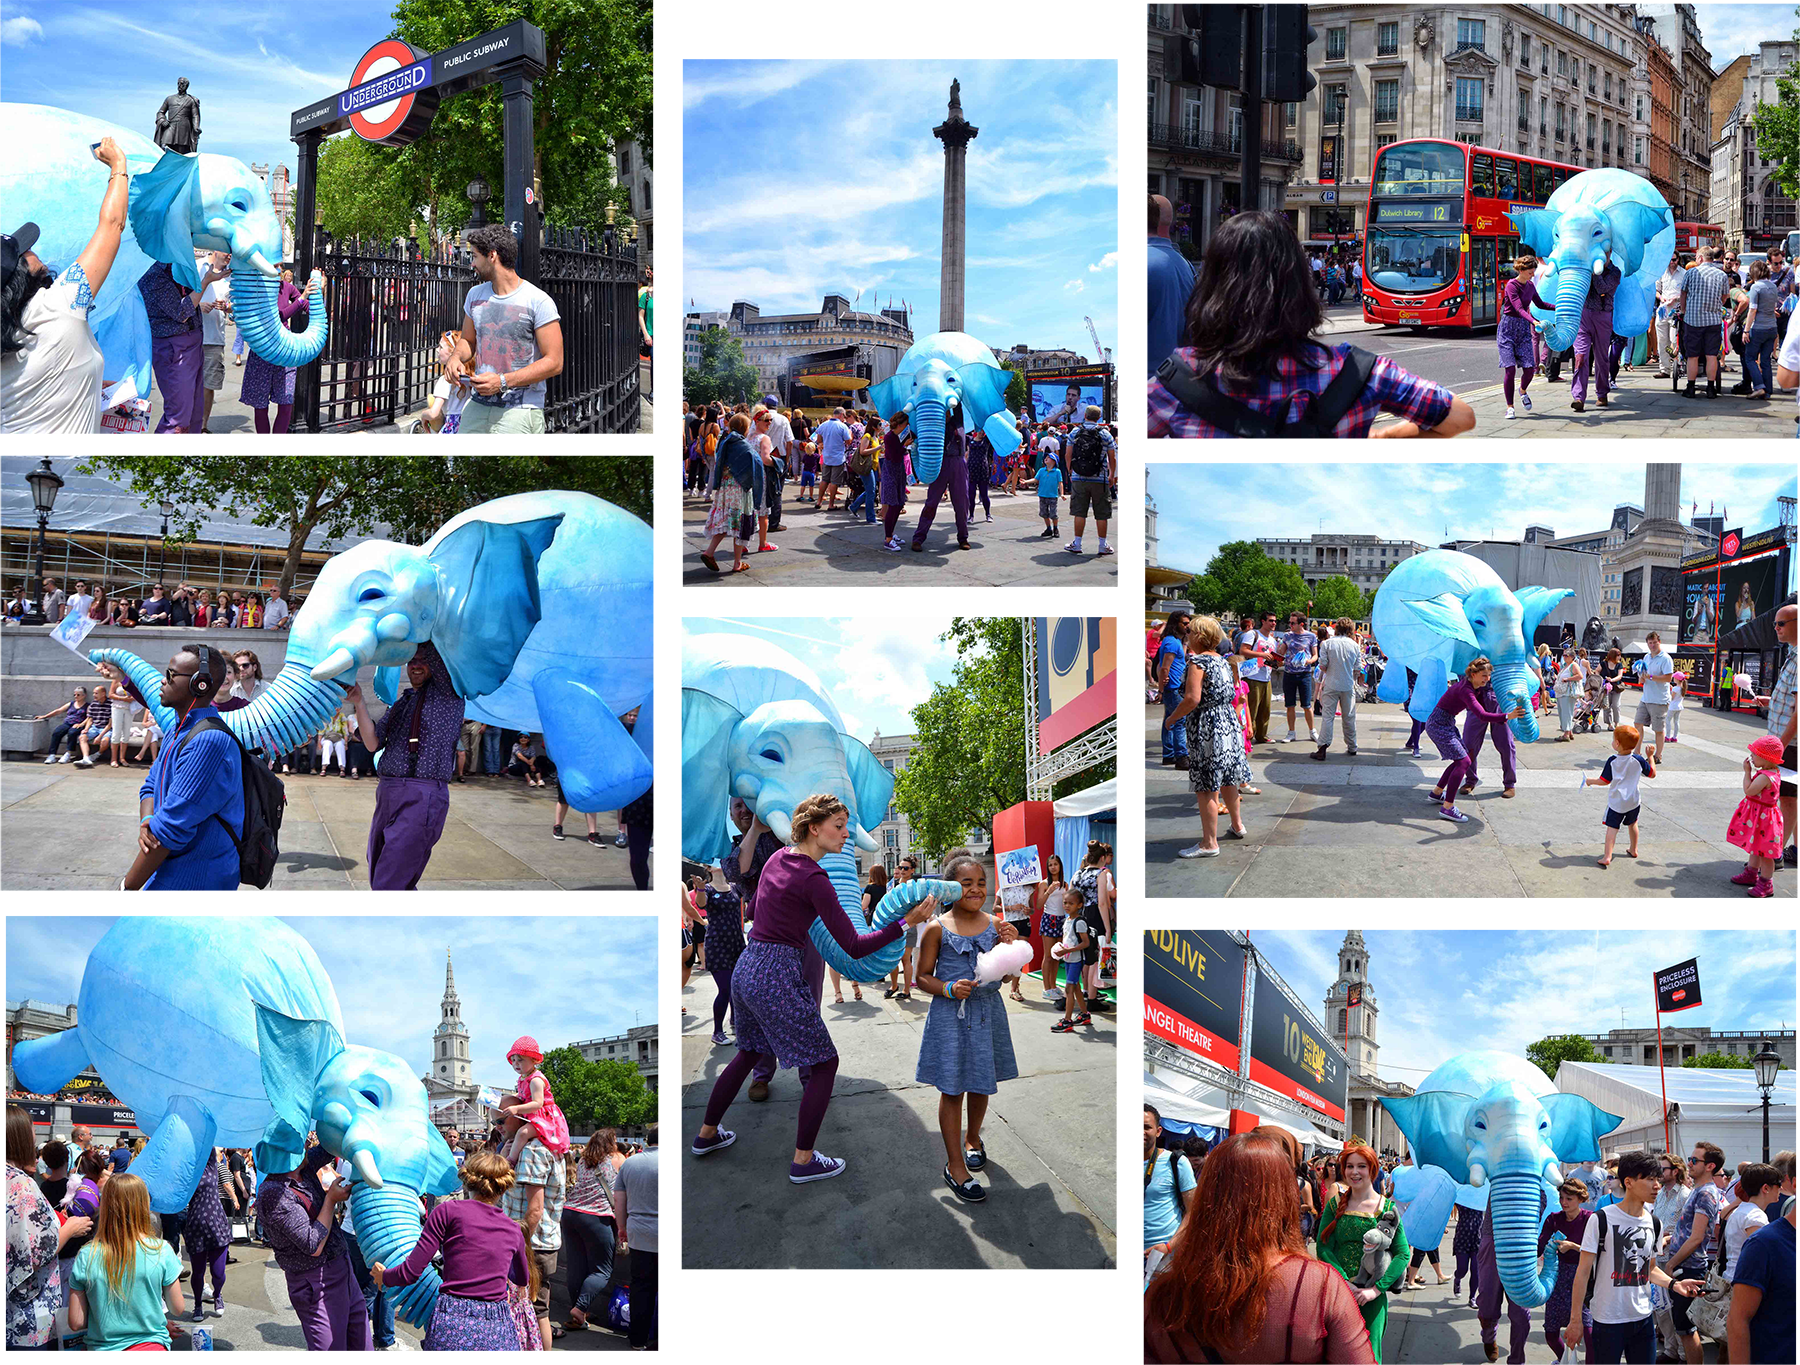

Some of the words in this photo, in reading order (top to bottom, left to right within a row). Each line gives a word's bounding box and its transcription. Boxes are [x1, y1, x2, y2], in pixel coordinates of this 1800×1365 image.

[444, 51, 472, 69] PUBLIC
[473, 36, 510, 57] SUBWAY
[341, 66, 426, 112] UNDERGROUND
[296, 113, 311, 125] PUBLIC
[311, 106, 331, 119] SUBWAY
[1380, 209, 1403, 217] Dulwich
[1404, 209, 1424, 219] Library
[1434, 206, 1445, 220] 12
[1061, 367, 1071, 376] 10
[1658, 965, 1696, 986] PRICELESS
[1660, 975, 1697, 993] ENCLOSURE
[1178, 1021, 1212, 1052] THEATRE
[1283, 1012, 1300, 1065] 10
